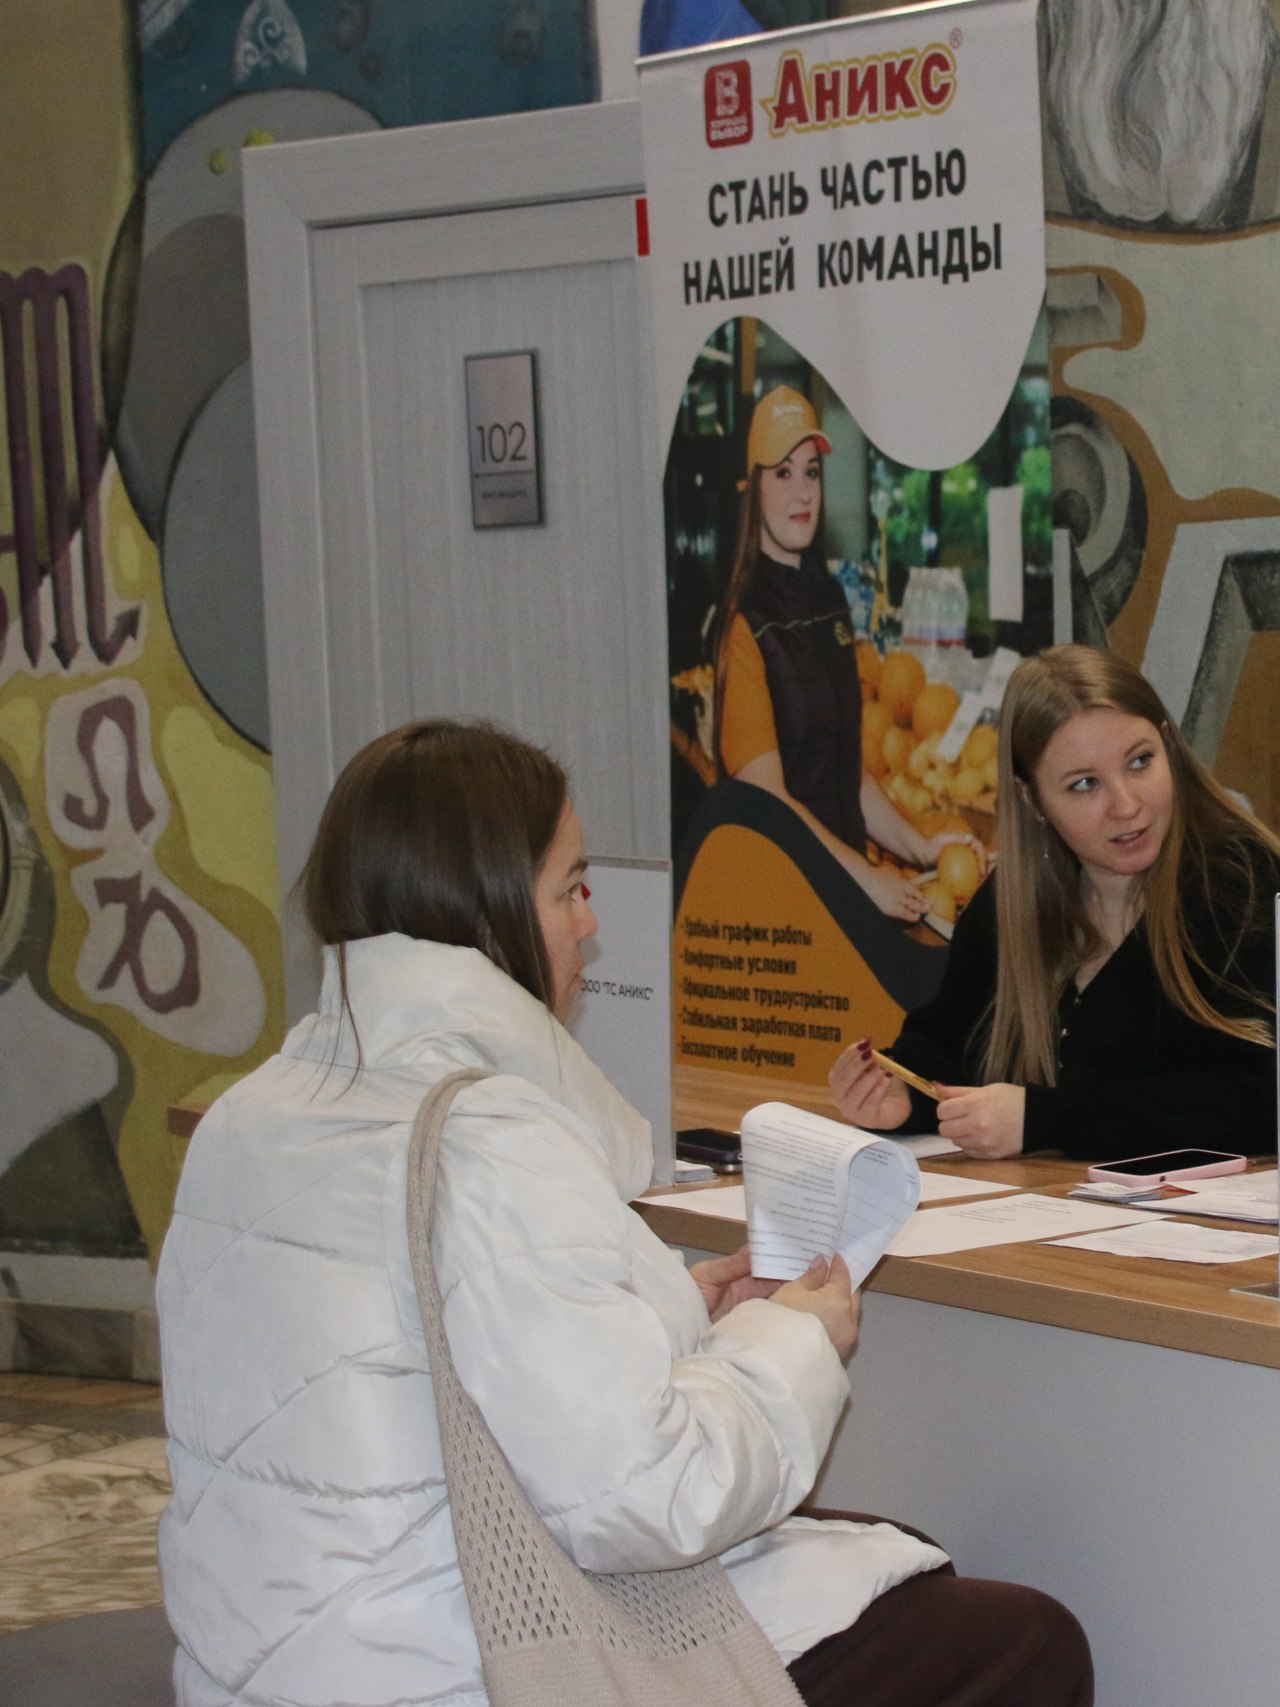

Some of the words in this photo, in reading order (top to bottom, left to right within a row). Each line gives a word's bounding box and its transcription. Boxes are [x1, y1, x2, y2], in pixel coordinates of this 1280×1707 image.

[708, 171, 809, 228] СТАНЬ
[820, 148, 967, 211] ЧАСТЬЮ
[683, 236, 796, 305] НАШЕЙ
[817, 222, 1003, 288] КОМАНДЫ
[477, 421, 527, 464] 102
[722, 922, 770, 945] график
[772, 924, 813, 947] работы
[747, 955, 798, 976] условия
[753, 986, 850, 1012] трудоустройство
[740, 1015, 807, 1039] заработная
[808, 1023, 842, 1043] плата
[741, 1043, 796, 1068] обучение
